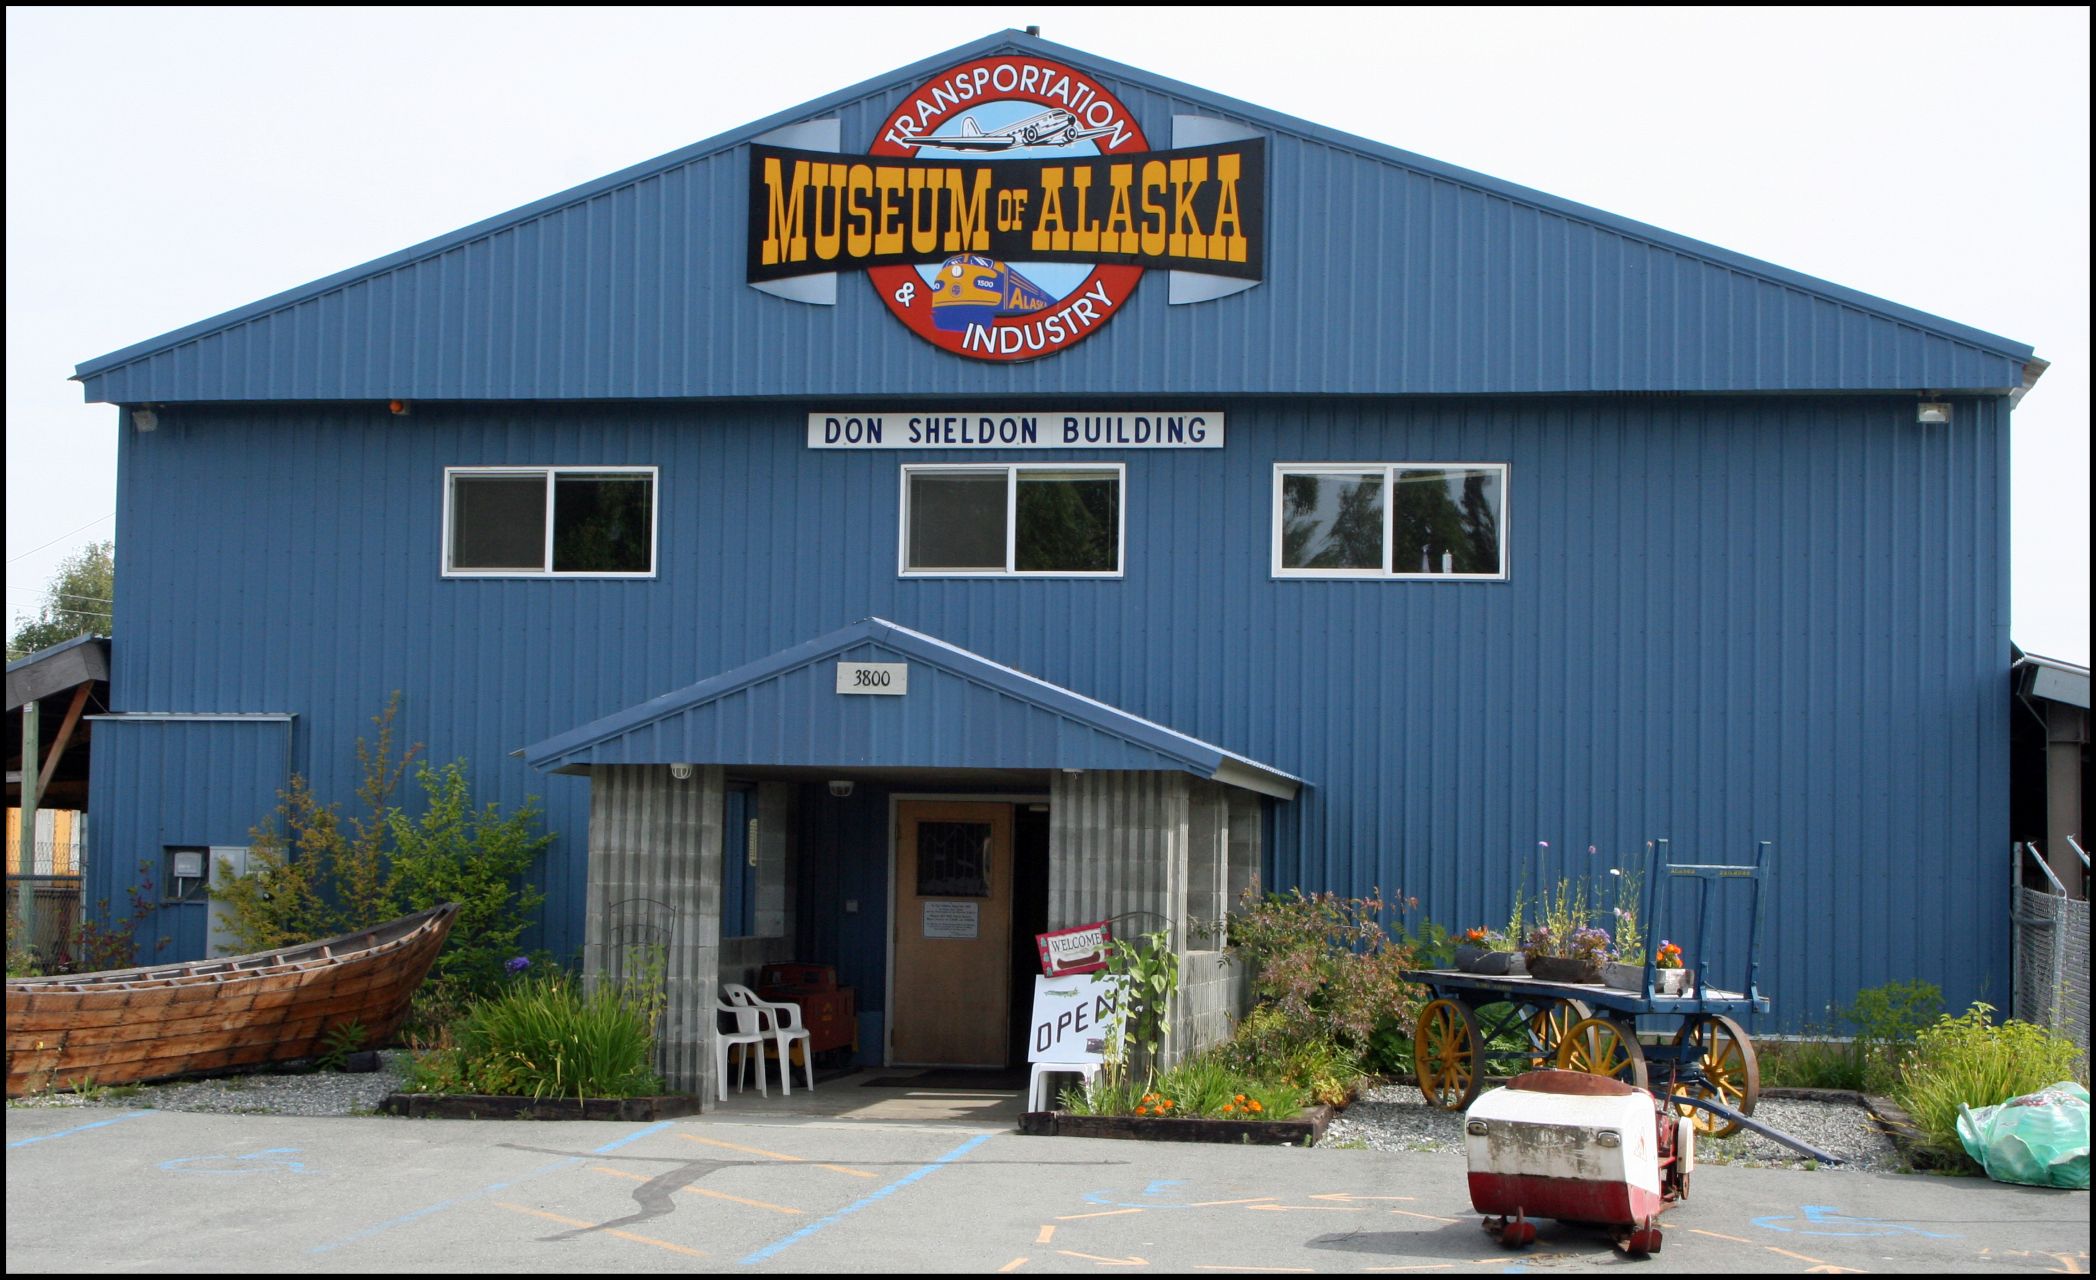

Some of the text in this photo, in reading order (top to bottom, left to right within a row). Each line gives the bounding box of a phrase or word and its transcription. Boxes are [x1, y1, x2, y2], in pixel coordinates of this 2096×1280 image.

[884, 64, 1133, 150] TRANSPORTATION
[761, 152, 1248, 265] MUSEUM OF ALASKA
[977, 280, 994, 288] 1500
[895, 280, 1112, 354] & INDUSTRY
[825, 417, 1206, 444] DON SHELDON BUILDING
[853, 669, 890, 687] 3800
[1051, 932, 1102, 953] WELCOME
[1036, 987, 1118, 1053] OPEN
